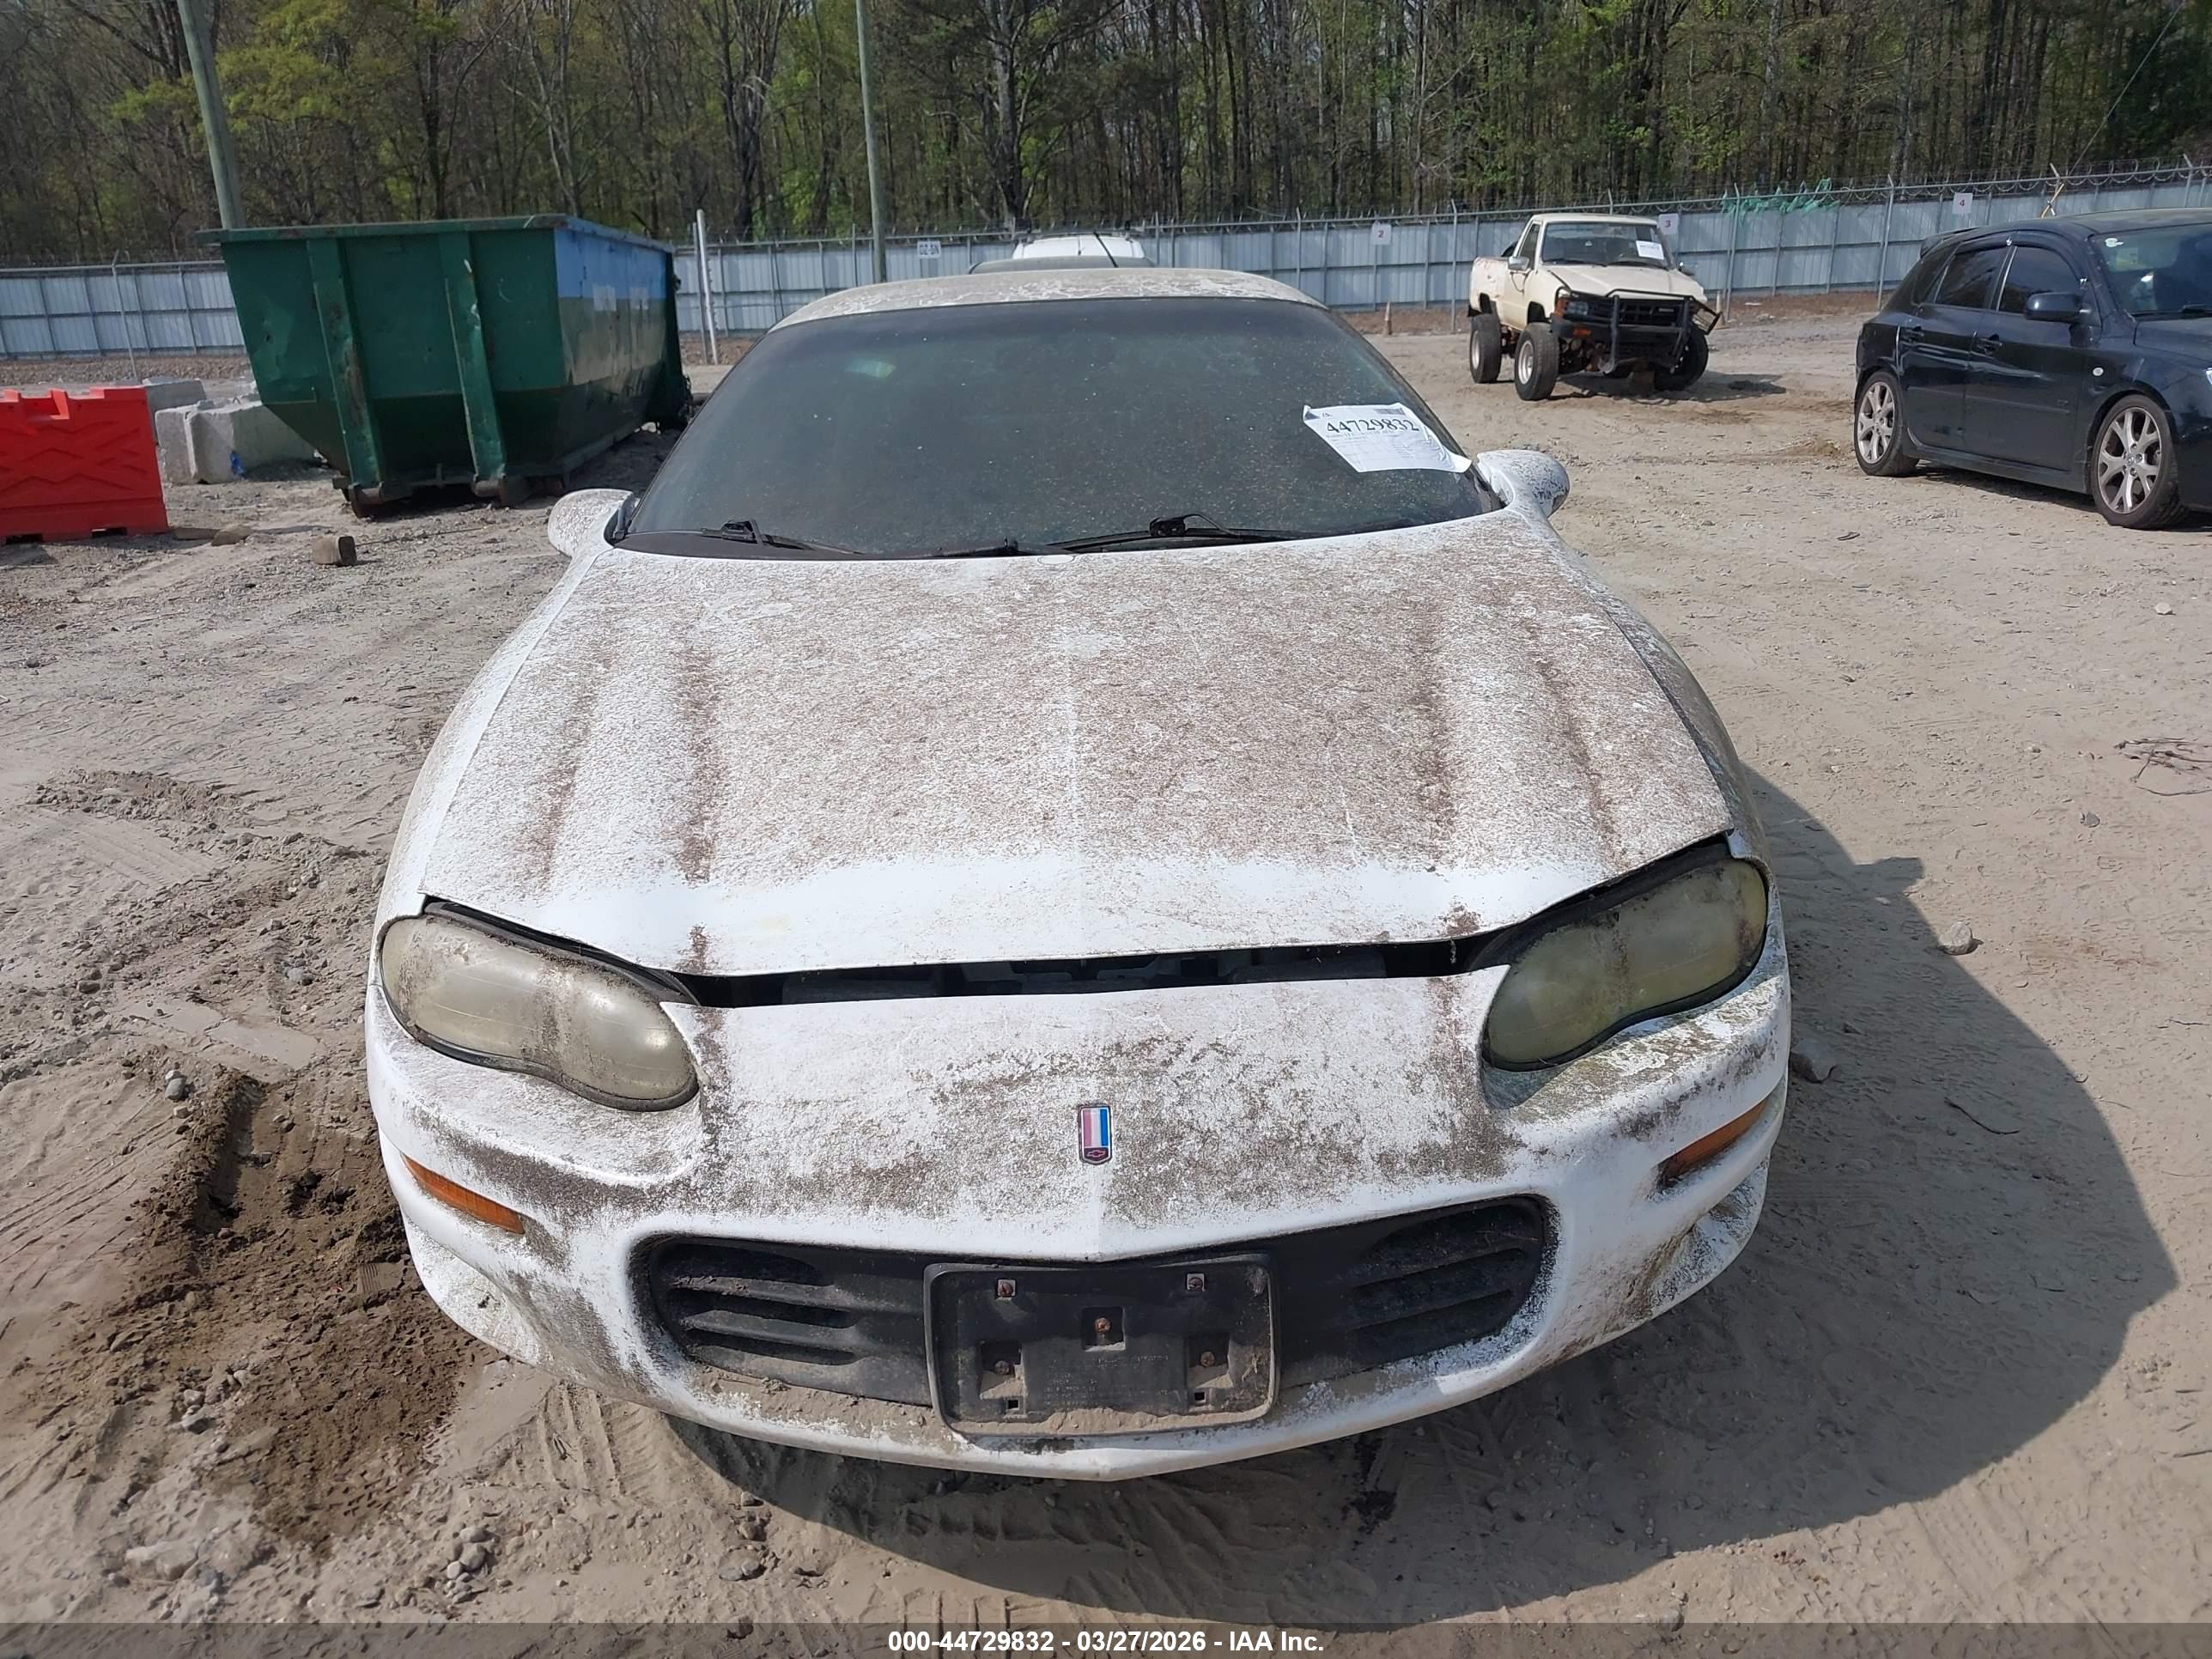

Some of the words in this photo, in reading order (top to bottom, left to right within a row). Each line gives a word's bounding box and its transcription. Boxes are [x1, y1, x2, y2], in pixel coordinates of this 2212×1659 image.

[1959, 198, 1966, 207] 4
[1664, 219, 1672, 228] 3
[1377, 229, 1385, 238] 2
[1327, 418, 1419, 434] 44729832
